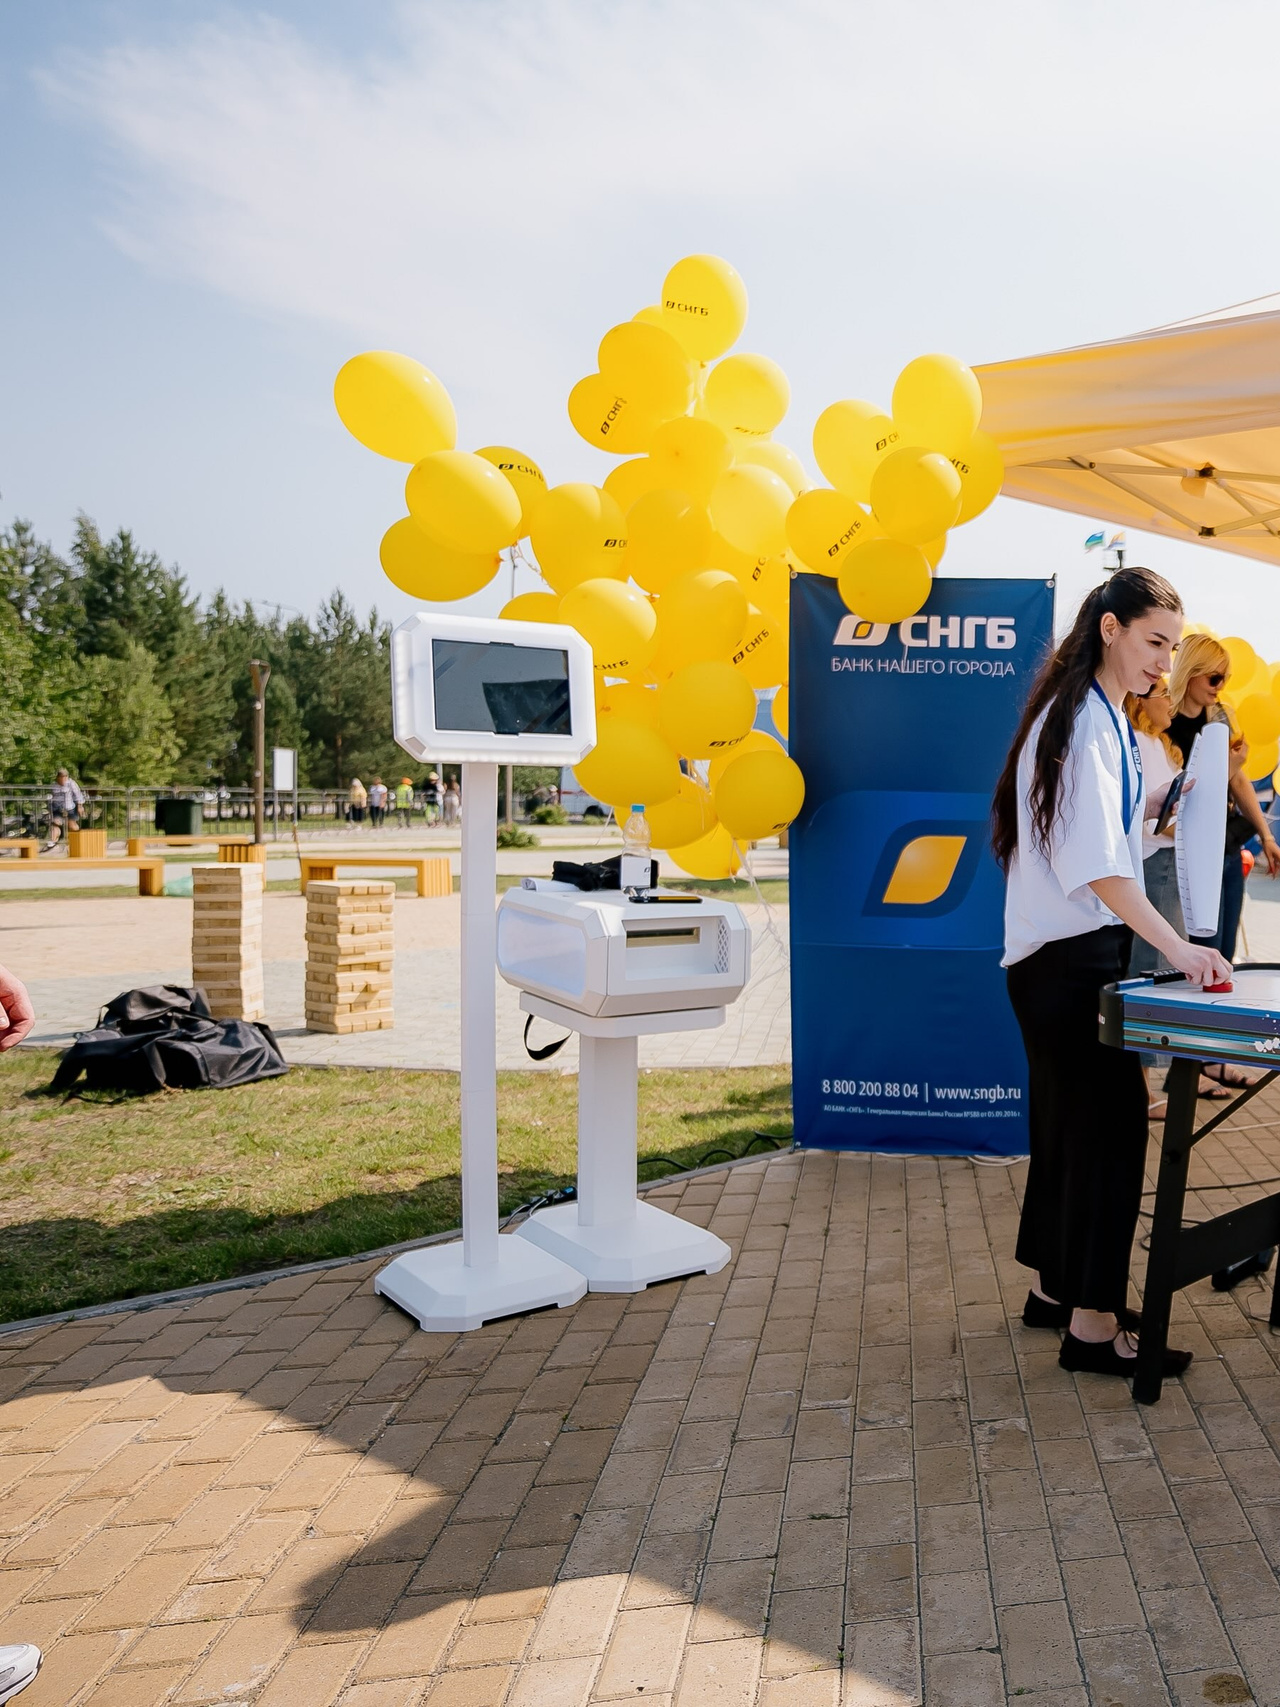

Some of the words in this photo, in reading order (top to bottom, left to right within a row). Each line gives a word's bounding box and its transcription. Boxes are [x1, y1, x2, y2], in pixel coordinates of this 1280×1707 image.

[677, 303, 709, 317] СНГБ
[840, 520, 861, 546] СНГБ
[745, 628, 770, 653] СНГБ
[899, 615, 1017, 649] СНГБ
[831, 657, 874, 673] БАНК
[877, 659, 946, 675] НАШЕГО
[949, 660, 1016, 678] ГОРОДА
[822, 1079, 830, 1094] 8
[833, 1080, 856, 1095] 800
[859, 1081, 882, 1096] 200
[884, 1082, 900, 1098] 88
[903, 1083, 919, 1098] 04
[935, 1084, 1021, 1103] www.sngb.ru
